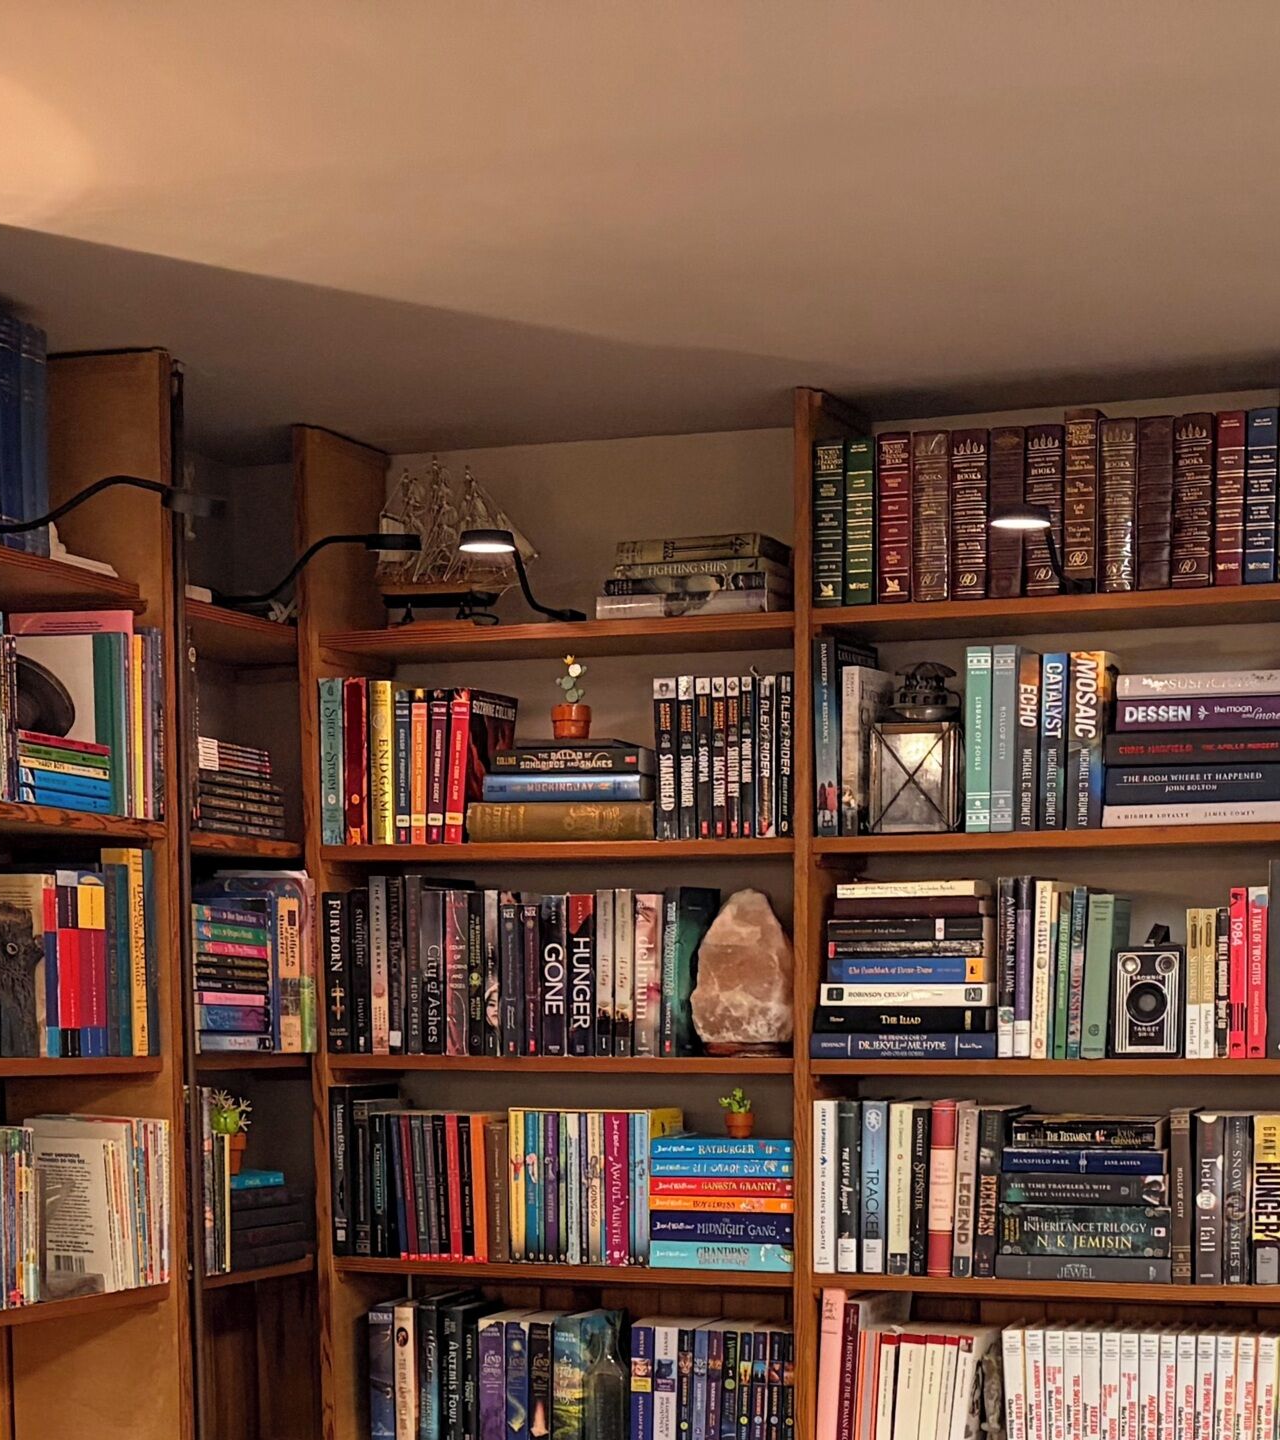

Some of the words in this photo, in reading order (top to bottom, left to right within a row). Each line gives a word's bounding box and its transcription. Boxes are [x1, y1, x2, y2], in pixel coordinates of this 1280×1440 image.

[648, 563, 698, 576] FIGHTING
[700, 561, 728, 573] SHIPS
[472, 700, 495, 716] SUZANNE
[780, 695, 791, 727] ALEX
[975, 696, 983, 729] LIBRARY
[1019, 683, 1037, 728] ECHO
[1044, 662, 1063, 739] CATALYST
[1074, 658, 1097, 738] MOSAIC
[1213, 705, 1227, 716] the
[323, 707, 338, 740] SIEGE
[1124, 705, 1192, 724] DESSEN
[496, 757, 517, 766] COLLINS
[550, 751, 583, 760] BALLAD
[579, 760, 613, 769] SNAKES
[698, 746, 709, 783] SCORPIA
[713, 756, 725, 779] EAGLE
[780, 738, 791, 775] RIDER
[974, 745, 982, 772] SOULS
[1079, 748, 1090, 779] MICHAEL
[324, 752, 338, 791] STORM
[378, 739, 390, 824] ENDGAME
[659, 754, 675, 811] SNAKEHEAD
[681, 755, 694, 807] STORMBREAKER
[1078, 782, 1089, 791] C.
[1122, 777, 1141, 786] THE
[1142, 776, 1168, 785] ROOM
[1170, 774, 1201, 784] WHERE
[1203, 774, 1213, 783] IT
[1215, 771, 1263, 782] HAPPENED
[526, 783, 595, 793] MOCKINGJAY
[713, 780, 725, 807] STRIKE
[1165, 784, 1185, 793] JOHN
[1186, 784, 1218, 792] BOLTON
[1078, 792, 1089, 826] GRUMLEY
[136, 883, 146, 928] HARRY
[1006, 896, 1015, 906] A
[328, 900, 343, 972] FURYBORN
[1006, 906, 1015, 952] WRINKLE
[1231, 917, 1244, 946] 1984
[1251, 915, 1262, 932] TALE
[1251, 933, 1262, 943] OF
[375, 937, 383, 975] LIBRARY
[424, 944, 440, 977] City
[1006, 955, 1015, 967] IN
[1251, 944, 1261, 961] TWO
[426, 981, 439, 995] of
[544, 943, 564, 1015] GONE
[572, 937, 590, 1029] HUNGER
[635, 935, 654, 1020] delirium
[1006, 970, 1015, 993] TIME
[1251, 962, 1261, 985] CITIES
[410, 977, 418, 1003] HEIDI
[411, 1006, 419, 1035] PERKS
[427, 997, 441, 1043] Ashes
[879, 1015, 898, 1025] THE
[899, 1015, 921, 1025] ILIAD
[336, 1104, 345, 1135] Masters
[698, 1144, 755, 1155] RATBURGER
[916, 1117, 924, 1156] DONNELLY
[1046, 1132, 1058, 1142] THE
[1059, 1131, 1092, 1143] TESTAMENT
[336, 1141, 345, 1171] Slayers
[610, 1162, 623, 1202] AWFUL
[701, 1182, 737, 1191] GANGSTA
[739, 1183, 777, 1192] GRANNY
[1176, 1167, 1184, 1199] HOLLOW
[1200, 1157, 1217, 1208] before
[865, 1168, 880, 1240] TRACKED
[957, 1172, 972, 1245] LEGEND
[977, 1174, 997, 1237] RECKLESS
[611, 1204, 623, 1246] AUNTIE
[696, 1223, 745, 1235] MIDNIGHT
[747, 1224, 776, 1237] GANG
[1023, 1221, 1097, 1234] INHERITANCE
[1097, 1222, 1147, 1234] TRILOGY
[1200, 1226, 1216, 1252] fall
[1036, 1235, 1050, 1250] N
[1056, 1236, 1068, 1249] K
[1073, 1236, 1132, 1251] JEMISIN
[1056, 1267, 1096, 1280] JEWEL
[448, 1340, 460, 1390] ARTEMIS
[448, 1393, 460, 1425] FOWL
[1090, 1405, 1099, 1435] HEIDI
